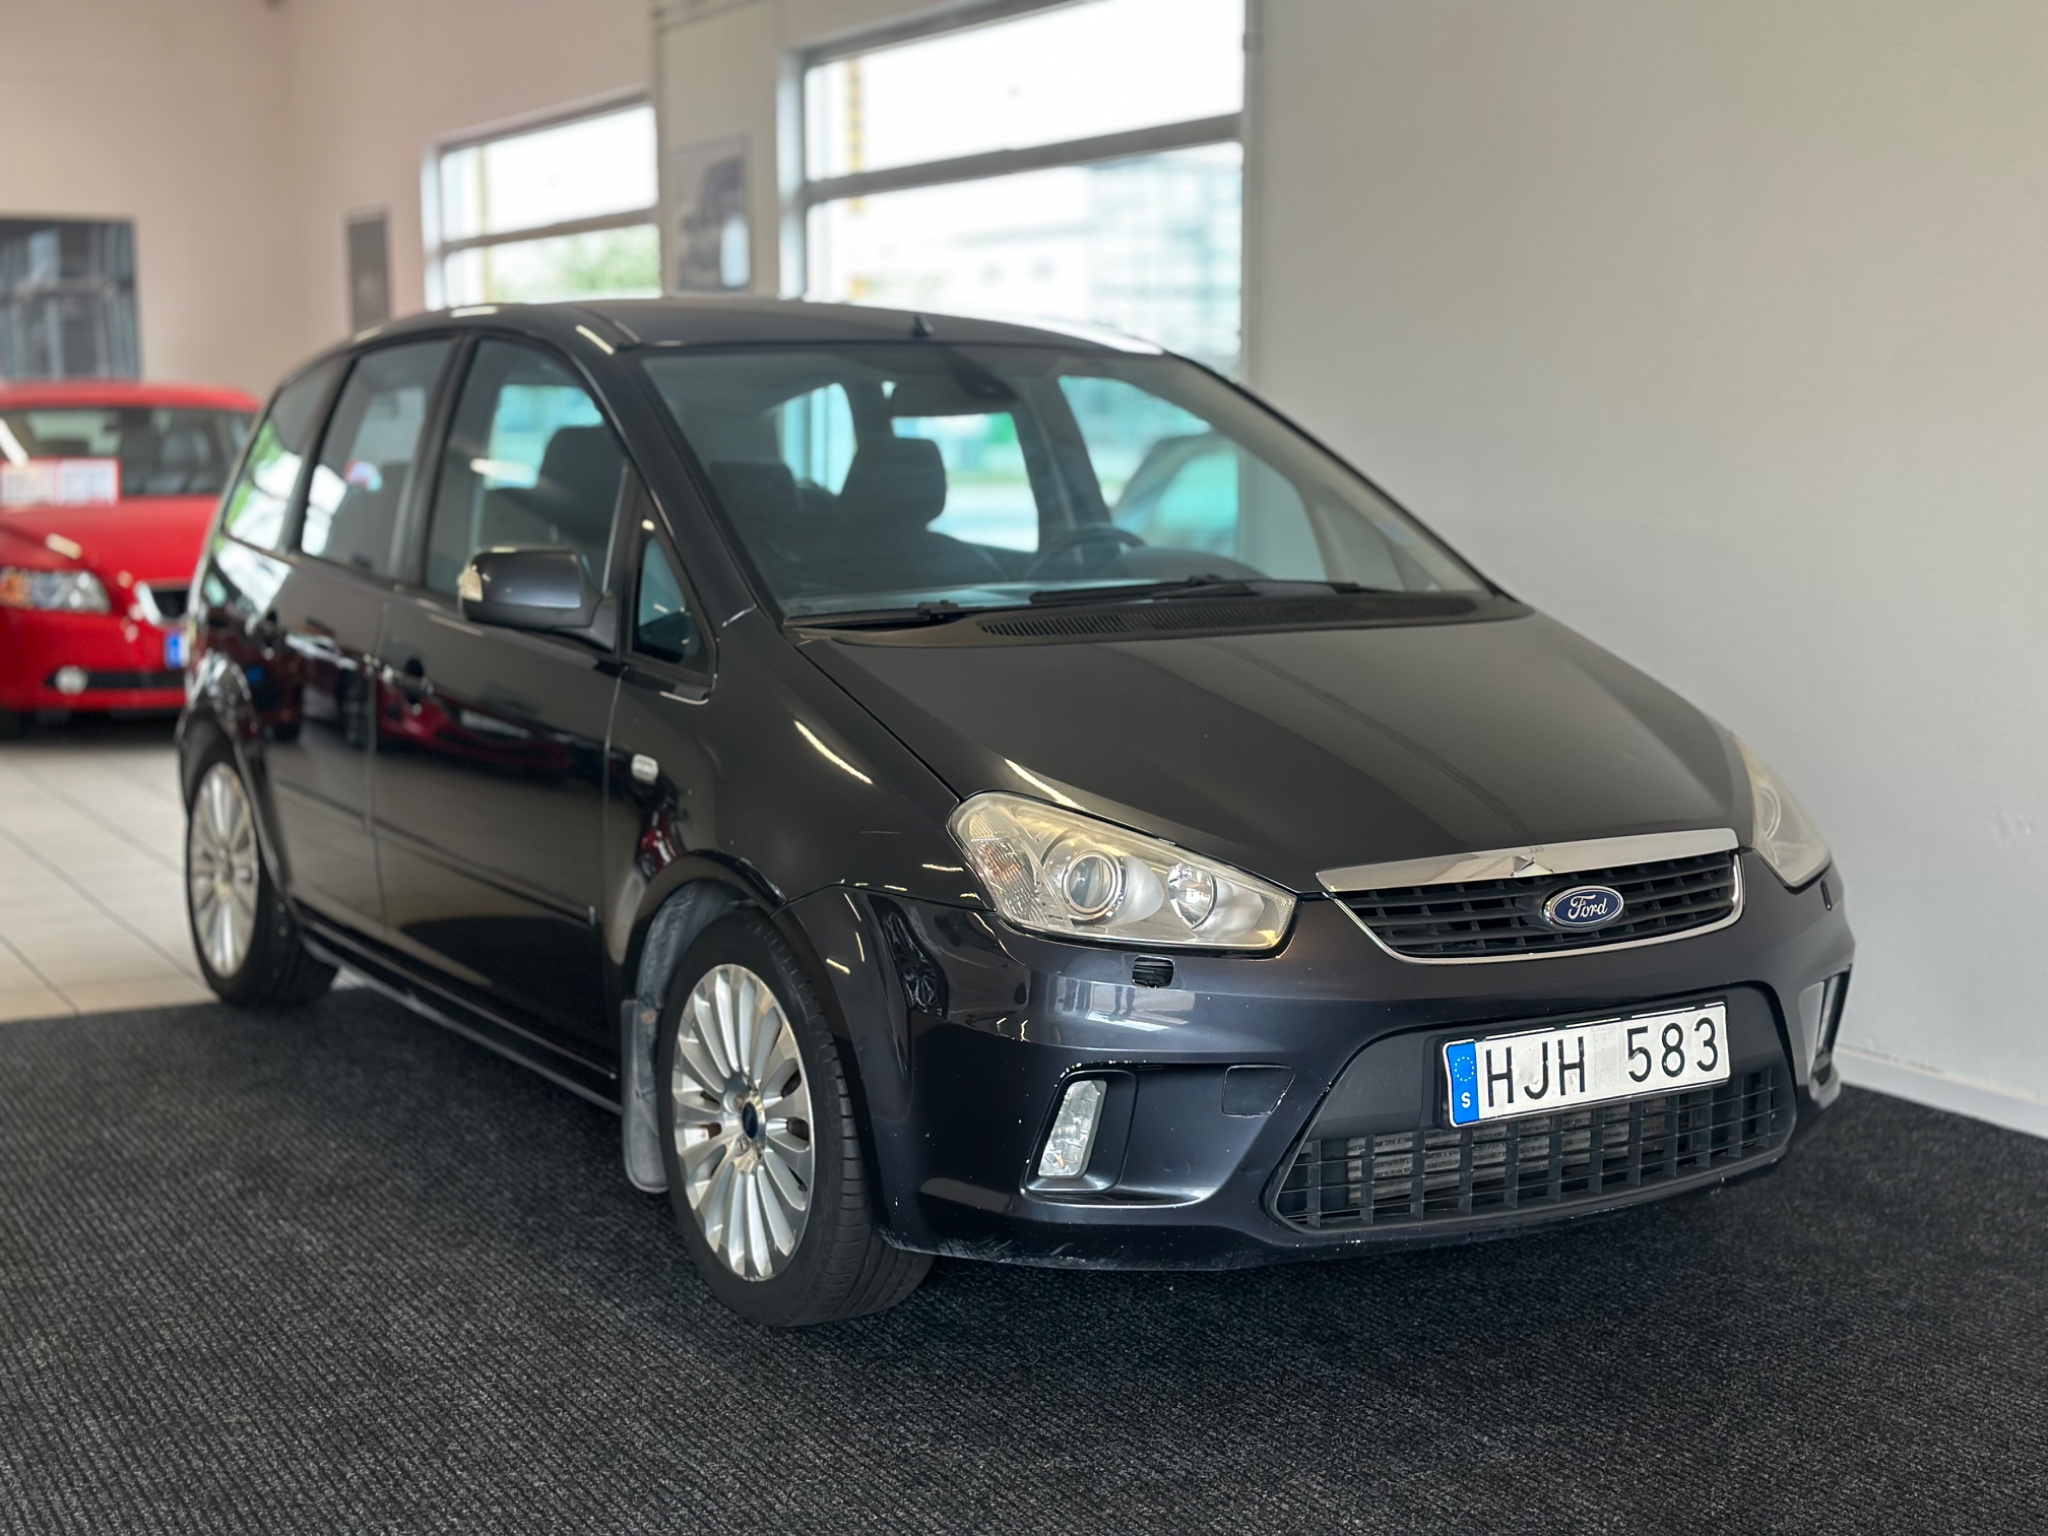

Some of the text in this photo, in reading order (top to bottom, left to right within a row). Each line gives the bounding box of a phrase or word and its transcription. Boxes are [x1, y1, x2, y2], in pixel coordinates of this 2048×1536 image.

[1567, 894, 1608, 919] Ford
[1485, 1016, 1720, 1108] HJH 583
[1461, 1091, 1471, 1109] S
